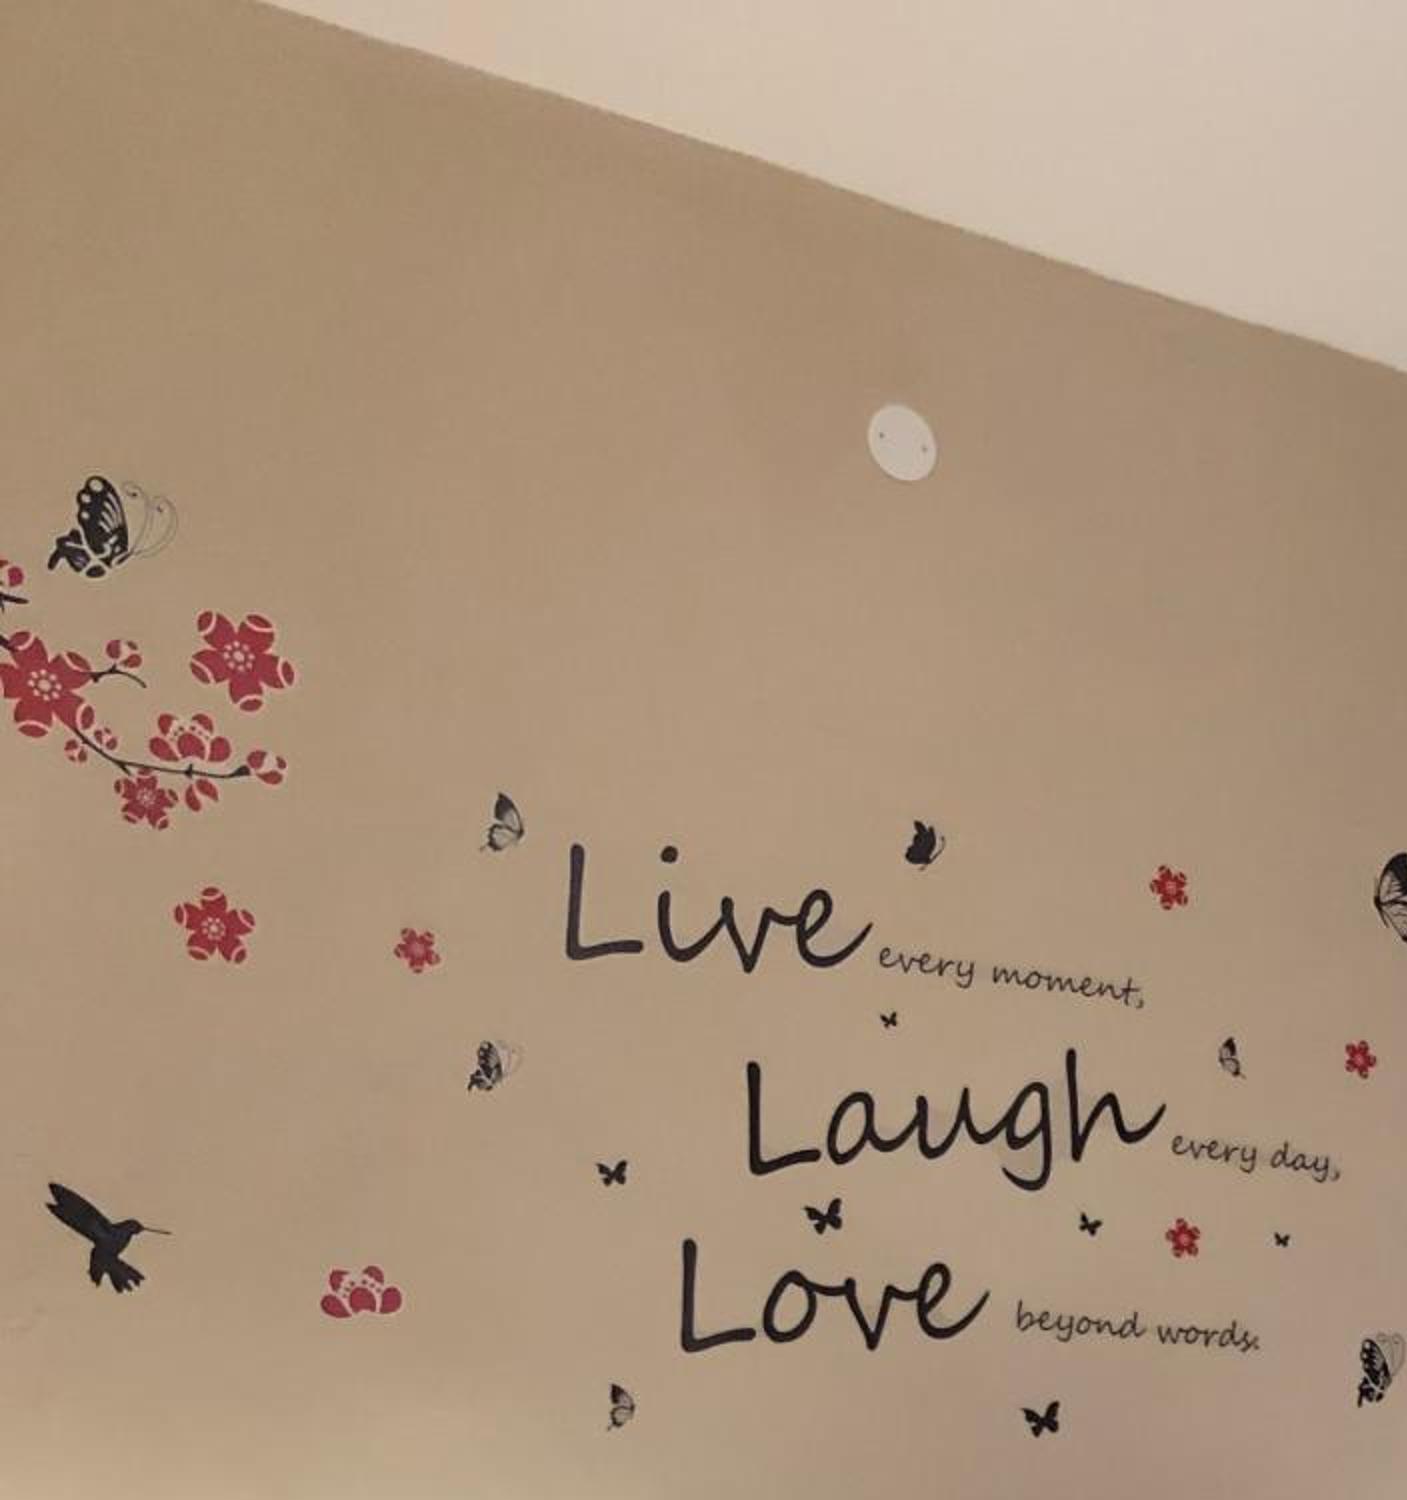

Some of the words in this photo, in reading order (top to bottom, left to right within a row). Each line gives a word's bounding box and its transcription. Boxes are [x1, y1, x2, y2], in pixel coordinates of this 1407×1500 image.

[566, 843, 874, 973] Live
[878, 946, 975, 990] every
[991, 965, 1145, 1009] moment,
[746, 1048, 1167, 1192] Laugh
[1171, 1134, 1258, 1174] every
[1269, 1141, 1341, 1183] day,
[680, 1238, 991, 1354] Love
[1015, 1299, 1148, 1343] beyond
[1156, 1310, 1261, 1354] words.
